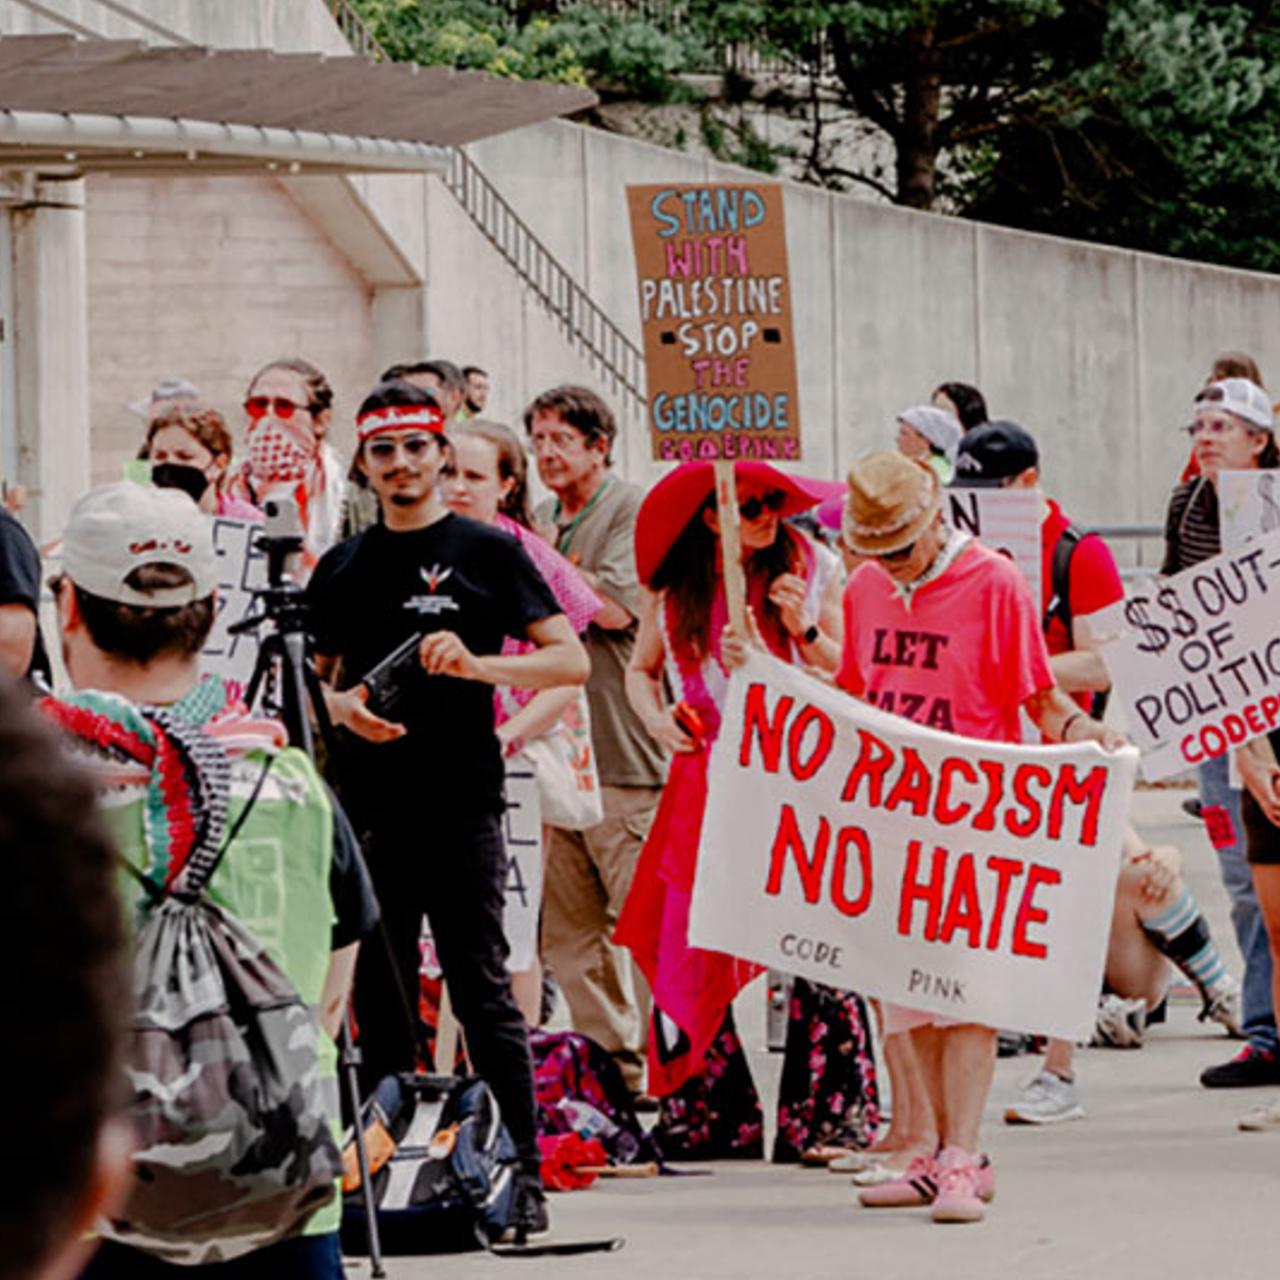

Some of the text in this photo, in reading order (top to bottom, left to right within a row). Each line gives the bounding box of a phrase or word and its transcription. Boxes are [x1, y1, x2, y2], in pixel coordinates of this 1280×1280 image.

[651, 187, 766, 238] STAND
[665, 236, 749, 278] WITH
[640, 276, 783, 320] PALESTINE
[692, 358, 750, 388] THE
[652, 391, 790, 432] GENOCIDE
[871, 627, 949, 671] LET
[1178, 621, 1236, 673] OF
[868, 690, 956, 735] AZA
[738, 681, 1108, 847] NO RACISM
[765, 803, 1063, 960] NO HATE
[780, 933, 844, 969] CODE
[907, 968, 966, 1001] PINK
